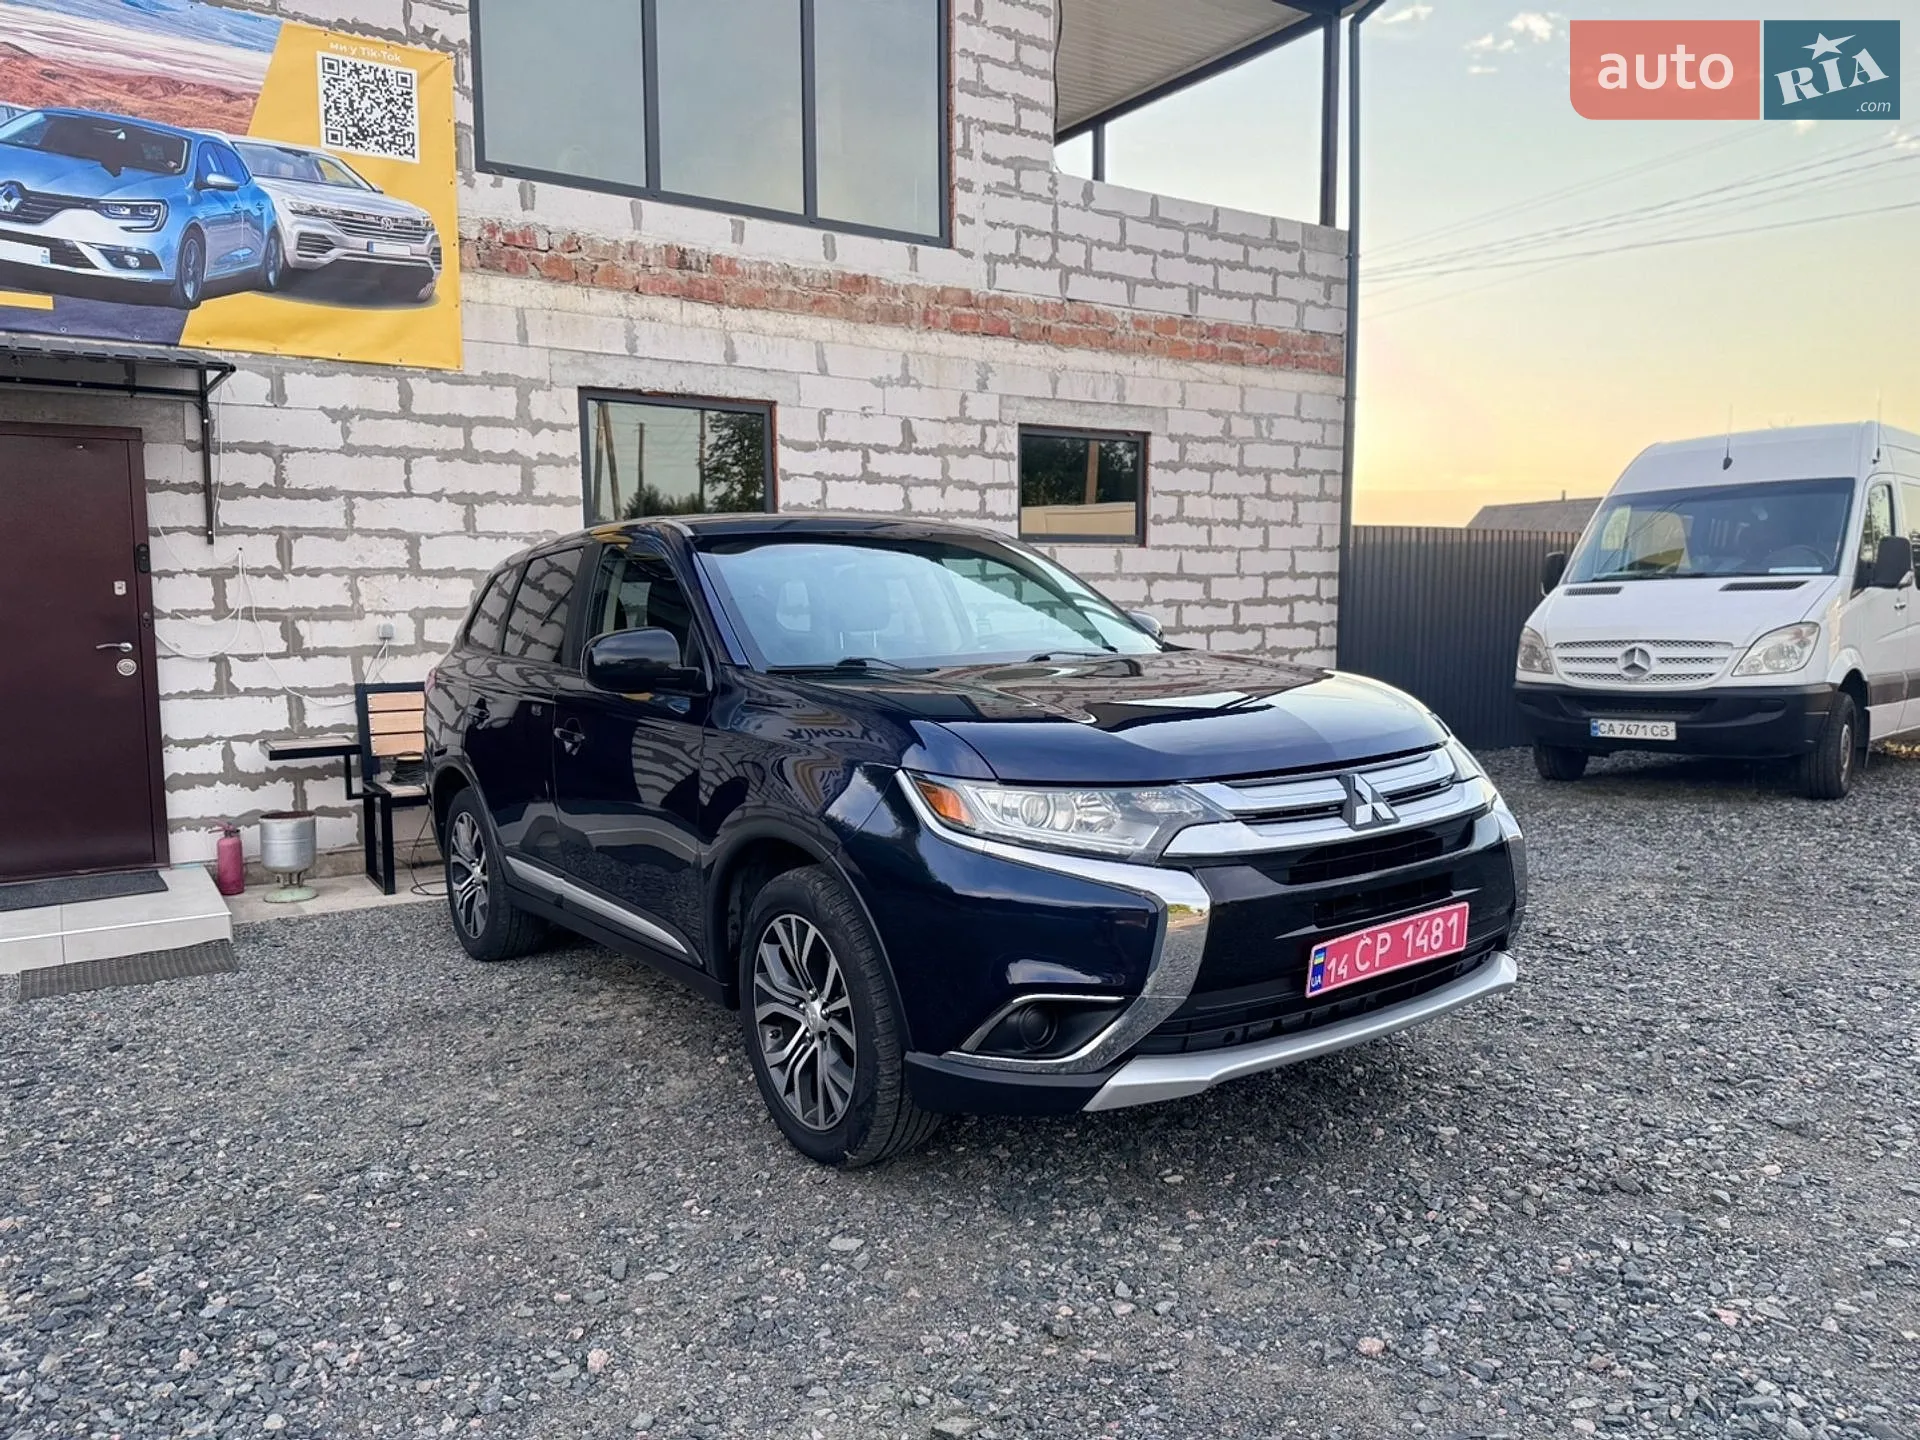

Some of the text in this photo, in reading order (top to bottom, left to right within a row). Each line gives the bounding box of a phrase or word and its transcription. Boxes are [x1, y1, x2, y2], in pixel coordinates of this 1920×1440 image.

[329, 42, 348, 53] ми
[360, 46, 402, 64] Tik-Tok
[1619, 723, 1648, 736] 7671
[1327, 953, 1348, 983] 14
[1402, 911, 1459, 958] 1481
[1310, 974, 1322, 988] UA
